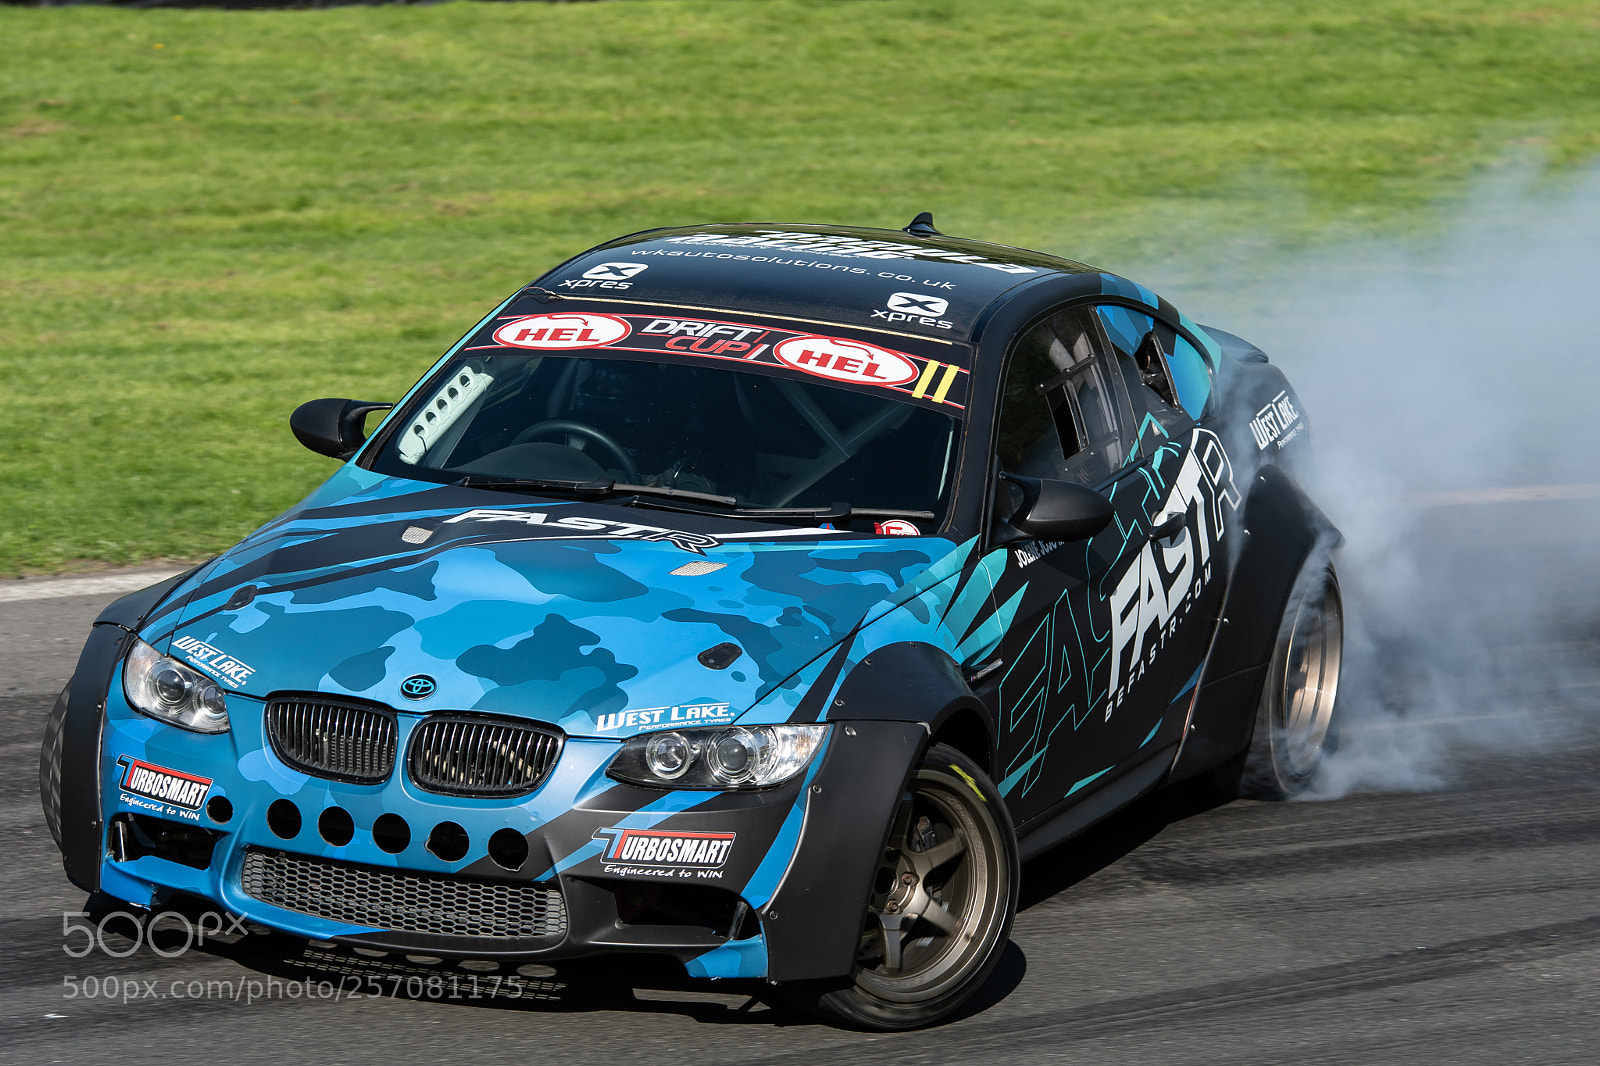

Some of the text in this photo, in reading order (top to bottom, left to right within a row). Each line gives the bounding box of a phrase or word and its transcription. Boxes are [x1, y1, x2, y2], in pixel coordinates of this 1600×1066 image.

[557, 277, 634, 290] xpres
[641, 319, 764, 341] DRIFT
[870, 308, 954, 330] xpres
[514, 328, 601, 342] HEL
[665, 335, 751, 355] CUP
[796, 349, 887, 380] HEL
[1248, 406, 1281, 451] WEST
[443, 509, 720, 555] FASTR
[1108, 427, 1242, 700] FASTR
[171, 635, 221, 660] WEST
[596, 708, 666, 732] WEST
[119, 755, 211, 807] TURBOSMART
[120, 793, 201, 821] Engineered to WIN
[600, 827, 734, 864] TURBOSMART
[604, 864, 724, 879] Engineered to WIN
